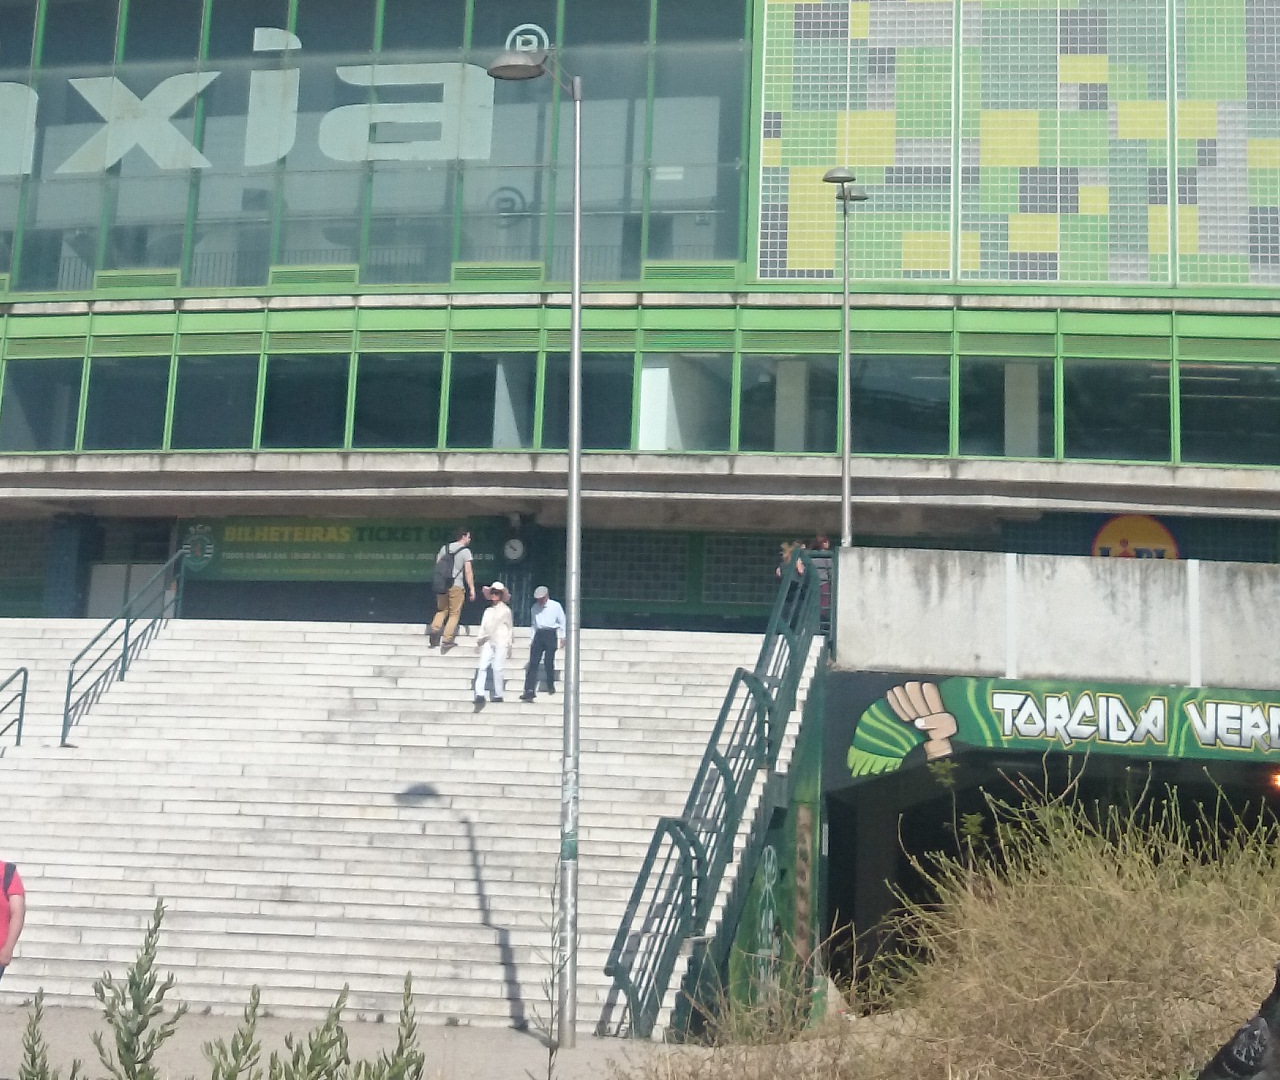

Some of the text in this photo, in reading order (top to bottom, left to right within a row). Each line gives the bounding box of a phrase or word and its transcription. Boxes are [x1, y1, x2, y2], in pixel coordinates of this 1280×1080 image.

[224, 525, 351, 543] BILHETEIRAS
[356, 525, 422, 542] TICKET
[991, 691, 1168, 748] TORCIDA
